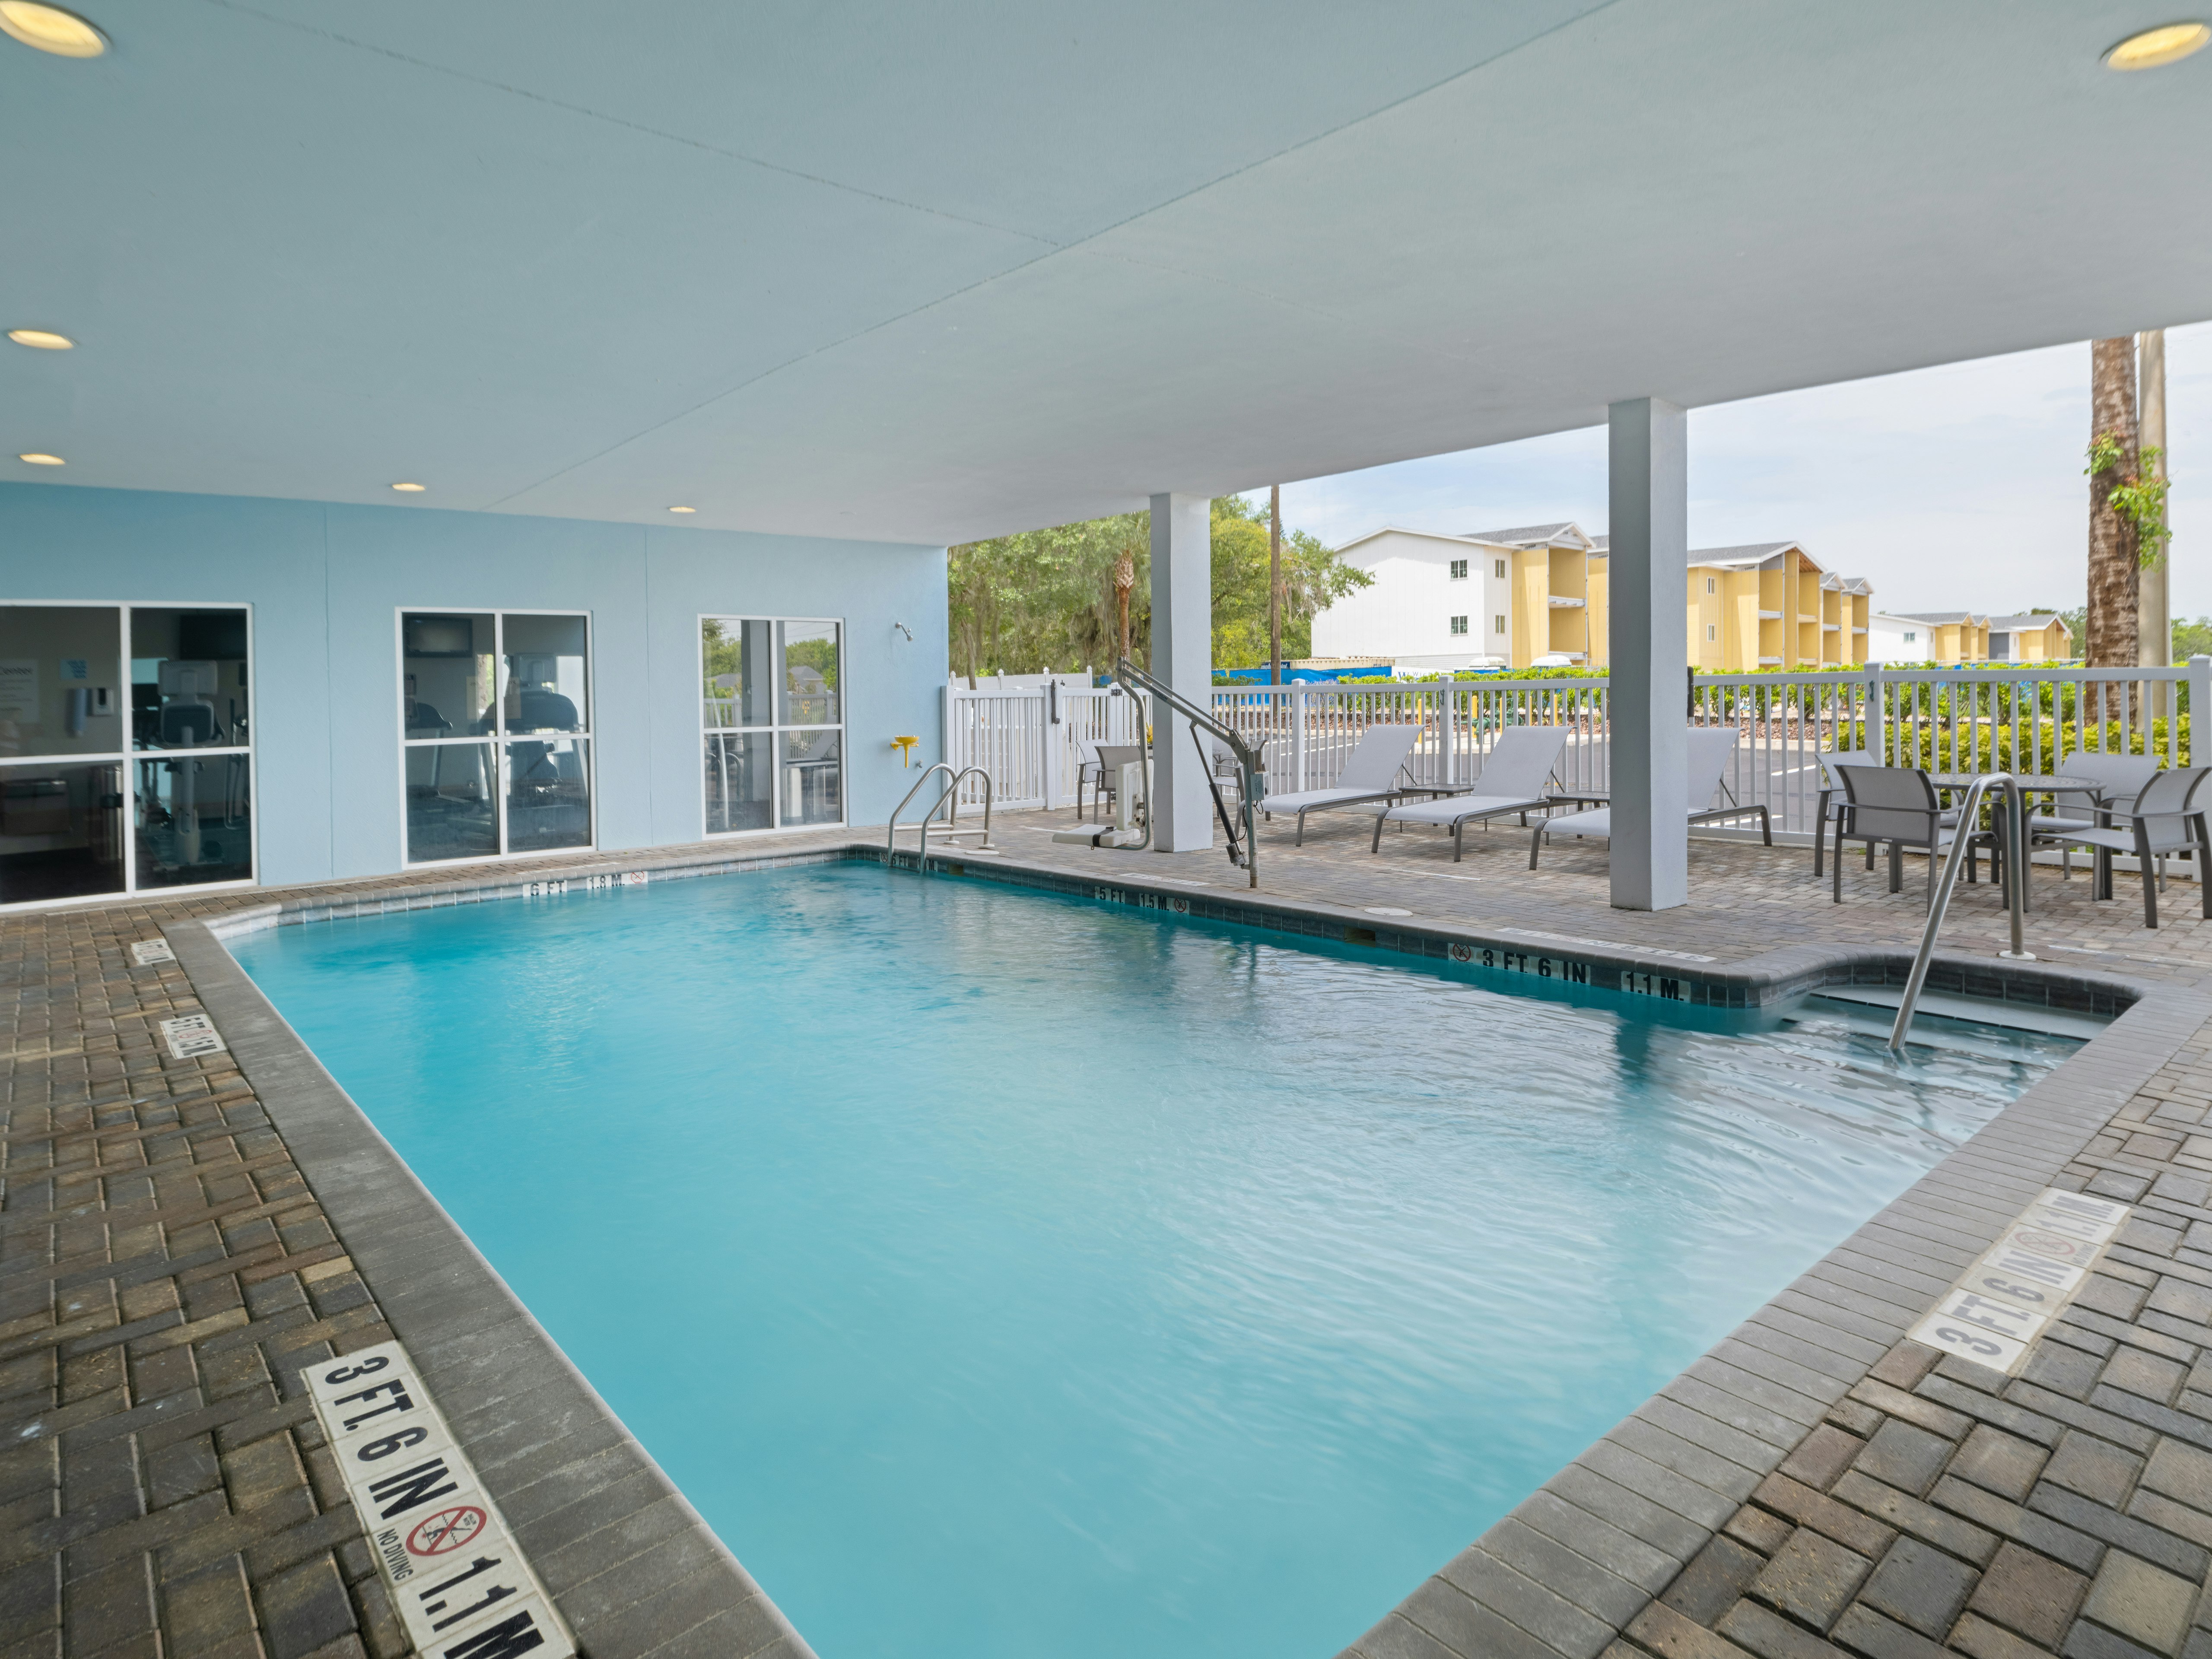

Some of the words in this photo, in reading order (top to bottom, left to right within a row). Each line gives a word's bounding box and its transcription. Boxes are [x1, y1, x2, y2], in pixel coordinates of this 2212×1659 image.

[1149, 687, 1168, 701] SPECTRUM
[530, 883, 540, 896] 6
[589, 875, 606, 889] 1.8
[611, 874, 625, 887] M.
[1100, 887, 1106, 900] 5
[1111, 889, 1124, 904] FT.
[1141, 893, 1154, 909] 1.5
[1158, 896, 1170, 911] M.
[1483, 949, 1494, 967] 3
[1503, 952, 1528, 974] FT.
[1538, 957, 1551, 977] 6
[1563, 961, 1587, 984] IN
[1626, 971, 1652, 995] 1.1
[1660, 977, 1684, 1001] M.
[2052, 1195, 2116, 1219] M.
[2035, 1210, 2101, 1237] 1.1
[1999, 1250, 2072, 1285] IN
[1982, 1278, 2045, 1302] 6
[1952, 1294, 2032, 1336] FT.
[1936, 1327, 2002, 1356] 3
[324, 1356, 390, 1385] 3
[334, 1378, 414, 1431] FT.
[357, 1426, 429, 1462] 6
[368, 1457, 459, 1521] IN
[377, 1528, 399, 1546] NO
[384, 1543, 413, 1581] DIVING
[418, 1555, 518, 1634] 1.1
